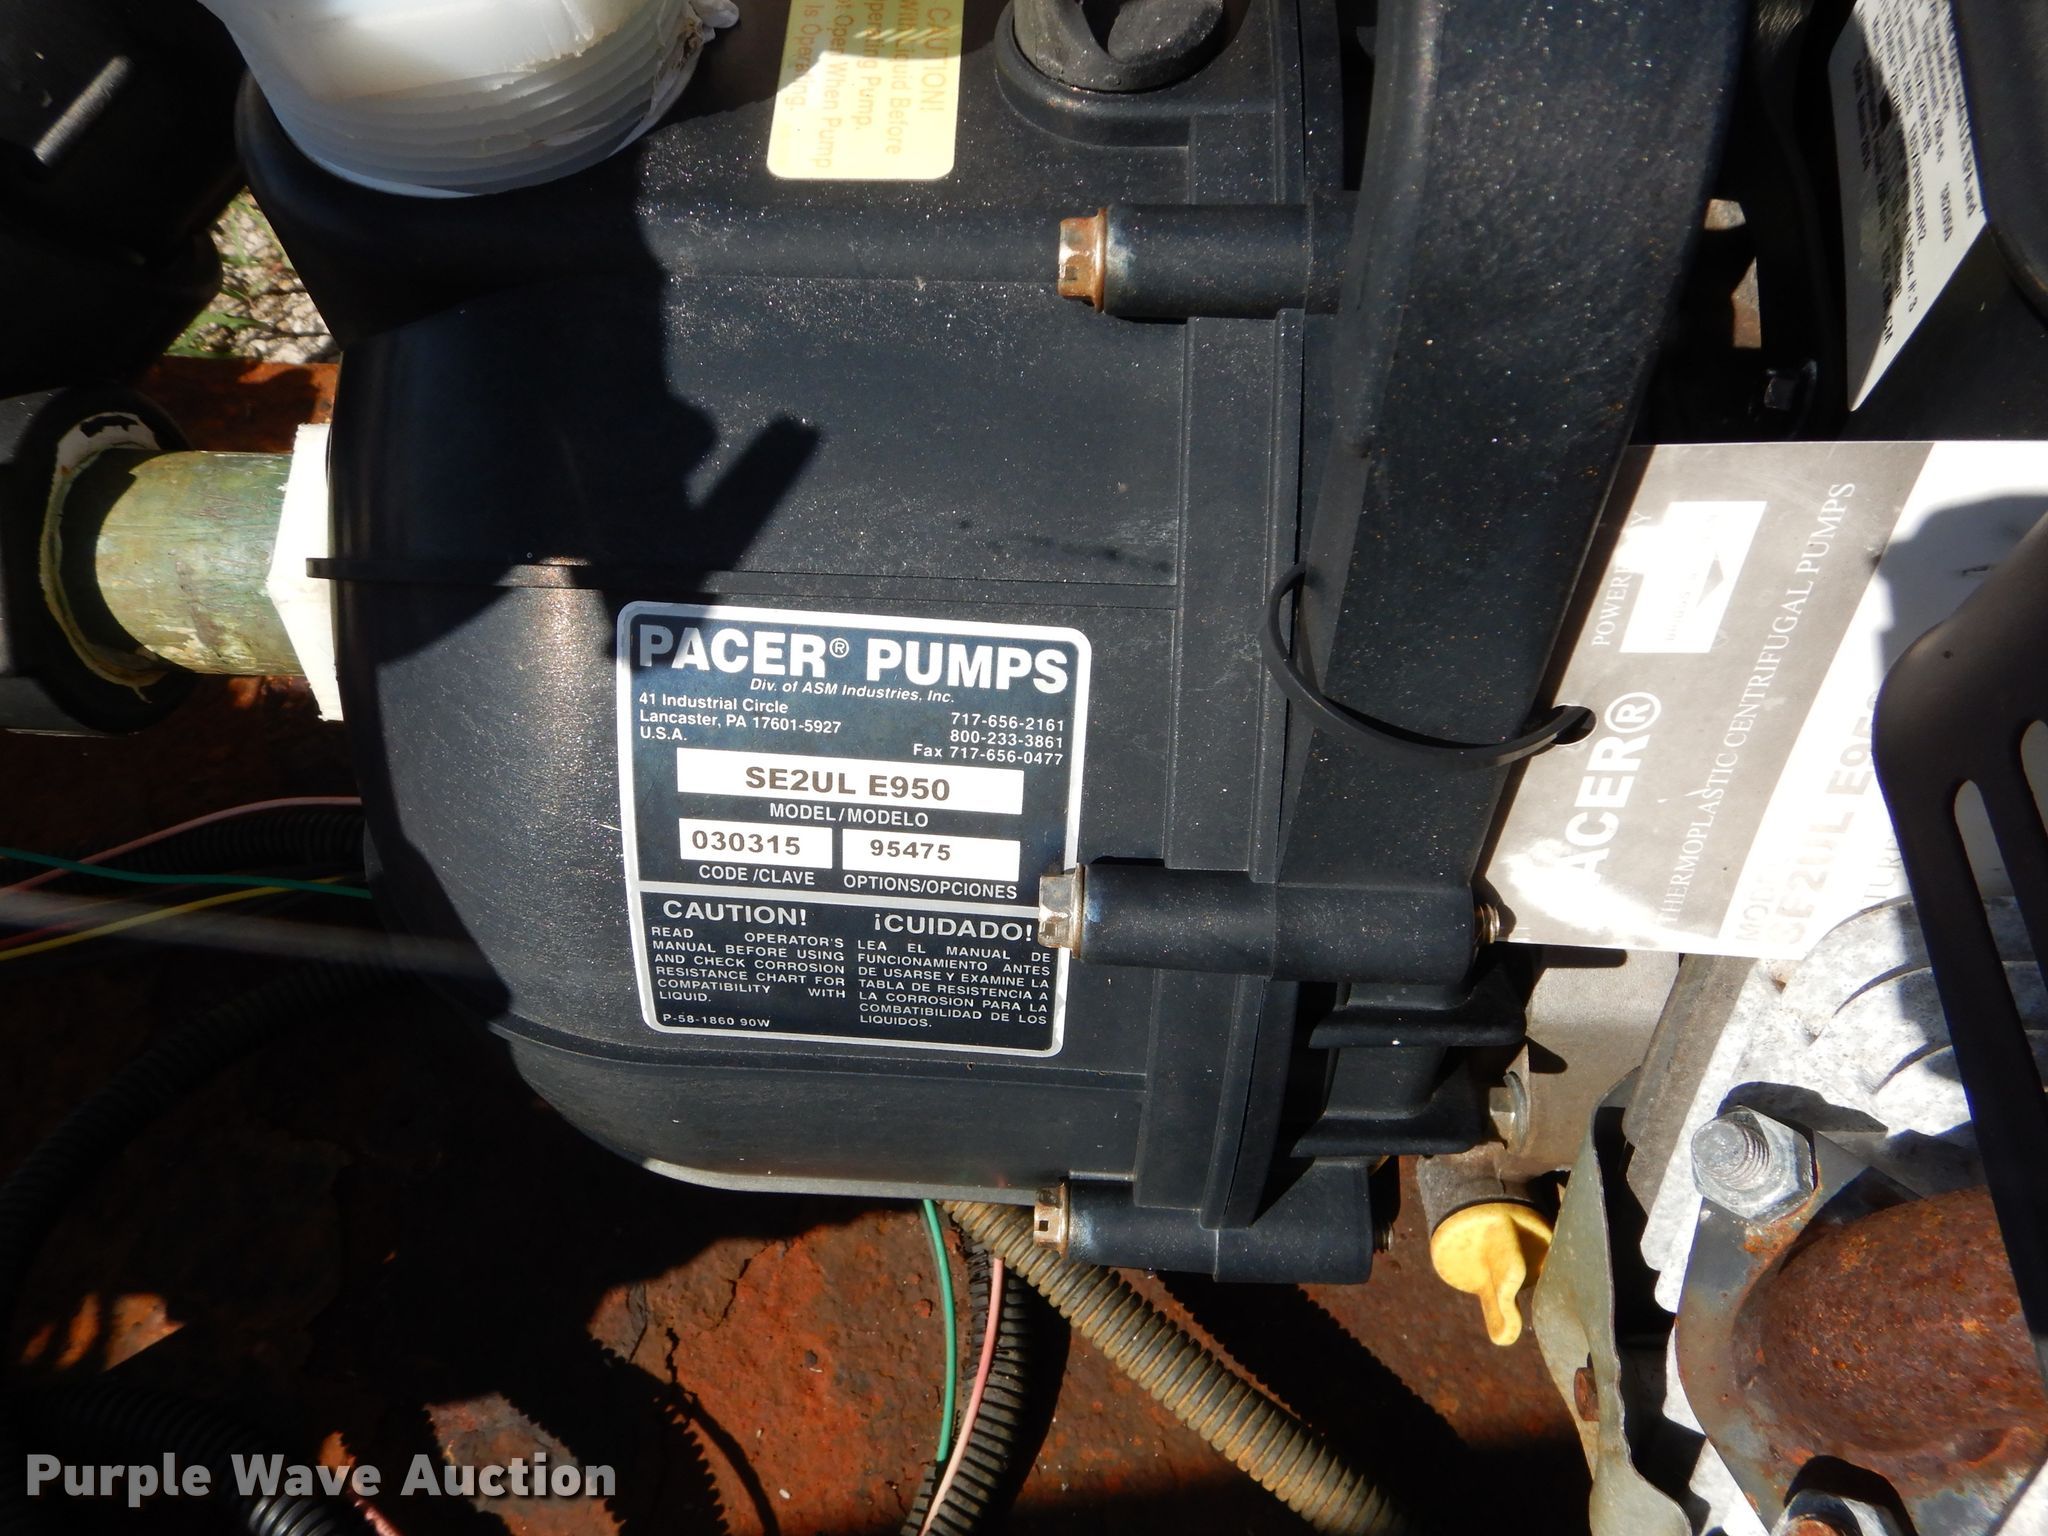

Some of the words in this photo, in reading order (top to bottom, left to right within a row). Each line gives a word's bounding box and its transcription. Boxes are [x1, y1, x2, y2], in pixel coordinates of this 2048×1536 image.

[858, 0, 884, 69] perating
[921, 8, 951, 112] CAUTION!
[823, 62, 849, 110] When
[851, 76, 881, 129] Pump.
[885, 97, 911, 156] Before
[811, 117, 843, 169] Pump
[1631, 512, 1652, 527] Y
[867, 638, 1068, 694] PUMPS
[751, 679, 777, 691] Div.
[783, 681, 798, 692] of
[802, 682, 837, 695] ASM
[842, 685, 922, 701] Industries,
[927, 690, 954, 703] Inc.
[639, 692, 655, 704] 41
[663, 694, 737, 710] Industrial
[743, 698, 788, 713] Circle
[1659, 753, 1738, 923] THERMOPLASTIC
[1725, 580, 1813, 747] CENTRIFUGAL
[1797, 483, 1855, 575] PUMPS
[640, 710, 721, 728] Lancaster,
[726, 714, 747, 728] PA
[753, 717, 841, 734] 17601-5927
[640, 726, 687, 740] U.S.A.
[951, 712, 1064, 732] 717-656-2161
[951, 730, 1062, 748] 800-233-3861
[913, 743, 942, 757] Fax
[950, 747, 1063, 765] 717-656-0477
[746, 766, 856, 795] SE2UL
[869, 775, 950, 801] E950
[692, 830, 800, 855] 030315
[870, 839, 951, 861] 95475
[699, 865, 747, 882] CODE
[844, 874, 1017, 899] OPTIONS/OPCIONES
[663, 900, 806, 926] CAUTION!
[651, 927, 693, 938] READ
[745, 933, 844, 948] OPERATOR'S
[653, 941, 716, 953] MANUAL
[725, 945, 787, 958] BEFORE
[797, 949, 844, 961] USING
[858, 940, 887, 951] LEA
[908, 943, 926, 953] EL
[947, 946, 1010, 960] MANUAL
[1032, 953, 1050, 962] DE
[655, 954, 685, 964] AND
[694, 956, 745, 967] CHECK
[755, 960, 845, 974] CORROSION
[858, 954, 988, 971] FUNCIONAMIENTO
[1003, 964, 1050, 976] ANTES
[656, 967, 748, 980] RESISTANCE
[757, 973, 806, 984] CHART
[815, 976, 845, 986] FOR
[858, 967, 877, 976] DE
[884, 969, 941, 980] USARSE
[946, 973, 955, 981] Y
[961, 973, 1024, 987] EXAMINE
[1032, 979, 1049, 988] LA
[658, 979, 771, 994] COMPATIBILITY
[808, 988, 846, 998] WITH
[660, 991, 711, 1002] LIQUID.
[858, 979, 904, 990] TABLA
[912, 983, 930, 992] DE
[938, 985, 1032, 1000] RESISTENCIA
[1039, 992, 1048, 1001] A
[859, 992, 877, 1001] LA
[886, 993, 973, 1007] CORROSION
[983, 1000, 1021, 1011] PARA
[1030, 1004, 1047, 1013] LA
[860, 1003, 982, 1019] COMBATIBILIDAD
[991, 1013, 1009, 1022] DE
[1019, 1015, 1046, 1024] LOS
[663, 1014, 735, 1026] P-58-1860
[740, 1019, 770, 1028] 90W
[860, 1015, 932, 1028] LIQUIDOS.
